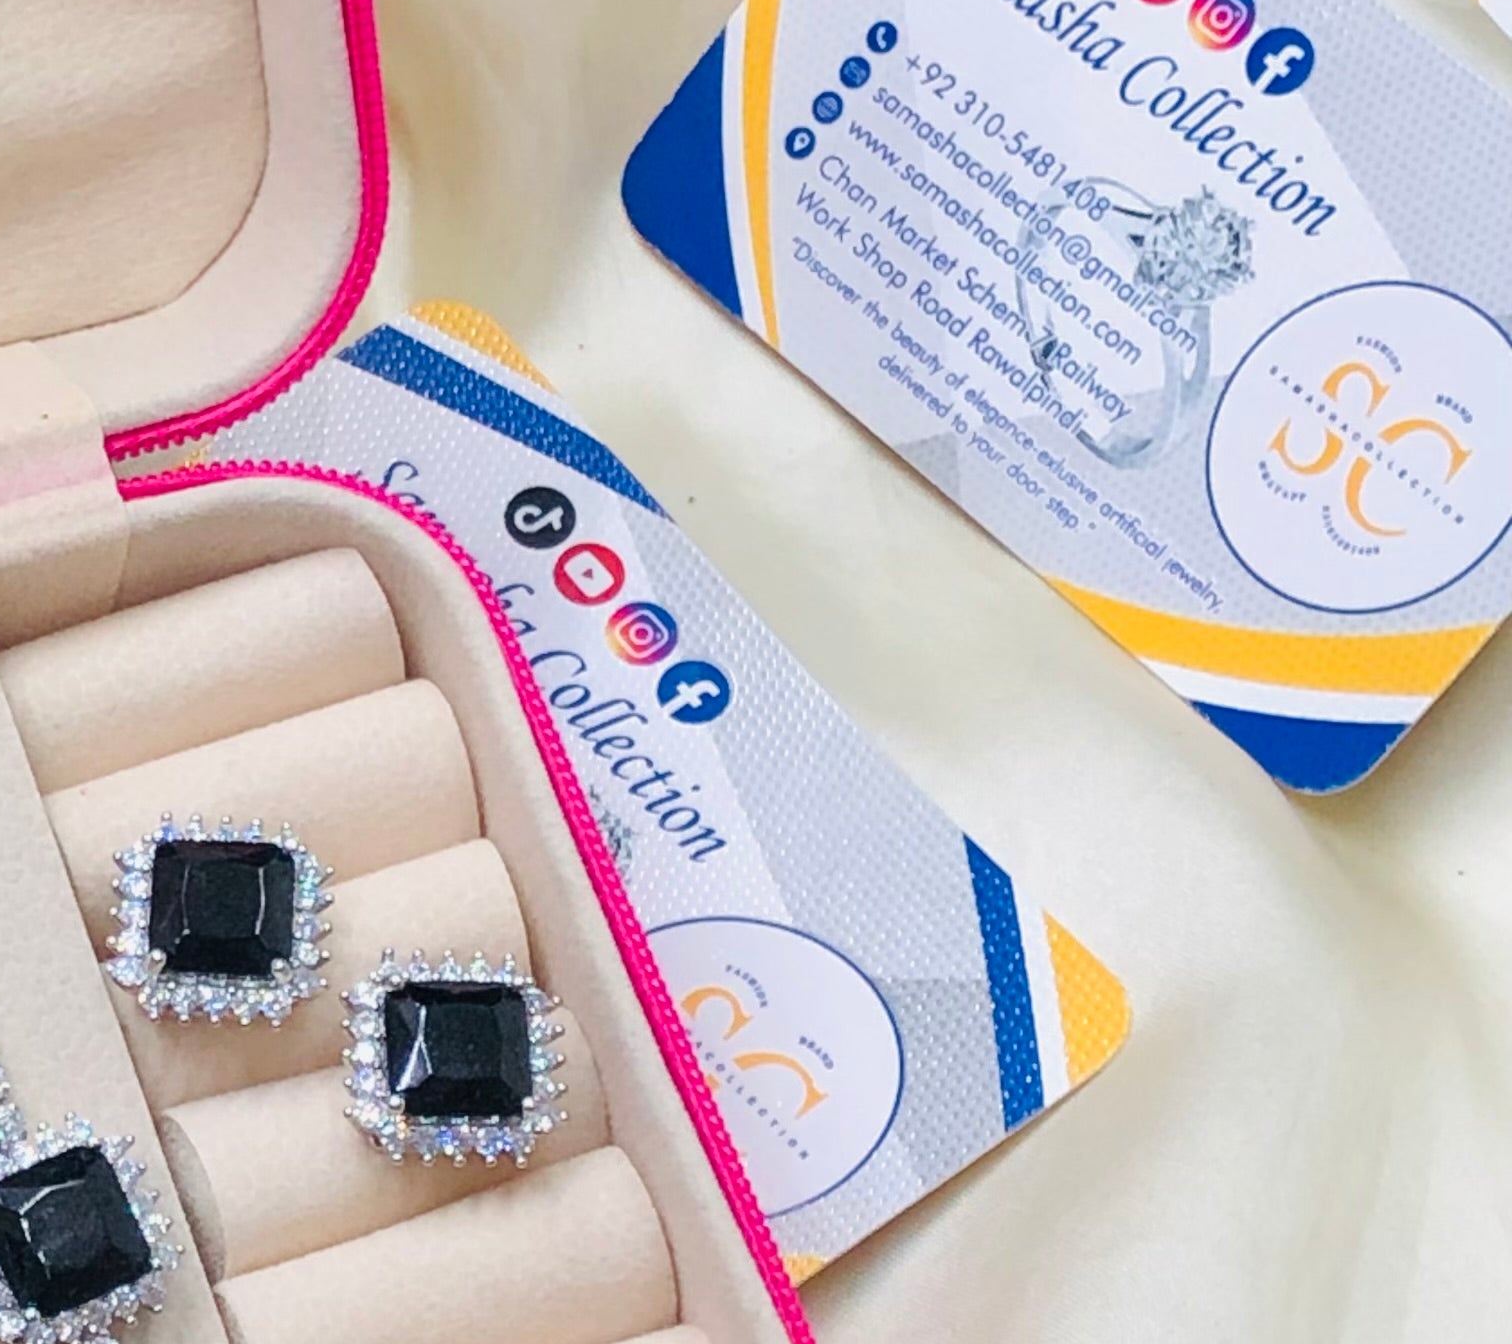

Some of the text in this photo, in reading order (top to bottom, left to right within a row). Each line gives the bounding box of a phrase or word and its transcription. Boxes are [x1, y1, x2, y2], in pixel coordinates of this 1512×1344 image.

[849, 121, 1141, 364] www.samashacollection.com
[872, 87, 1199, 352] samashacollection@gmail.com
[907, 56, 1110, 221] +92 310-5481408
[1120, 56, 1336, 235] Collection
[797, 183, 1088, 434] Work Shop Road Rawalpindi
[820, 155, 877, 213] Chan
[879, 206, 958, 275] Market
[1054, 342, 1133, 423] Railway
[862, 300, 889, 329] the
[891, 321, 944, 375] beauty
[945, 373, 969, 390] of
[1100, 503, 1167, 560] artificial
[879, 355, 953, 418] delivered
[951, 413, 970, 435] to
[966, 431, 1007, 467] your
[1007, 464, 1044, 496] door
[529, 649, 727, 862] Collection
